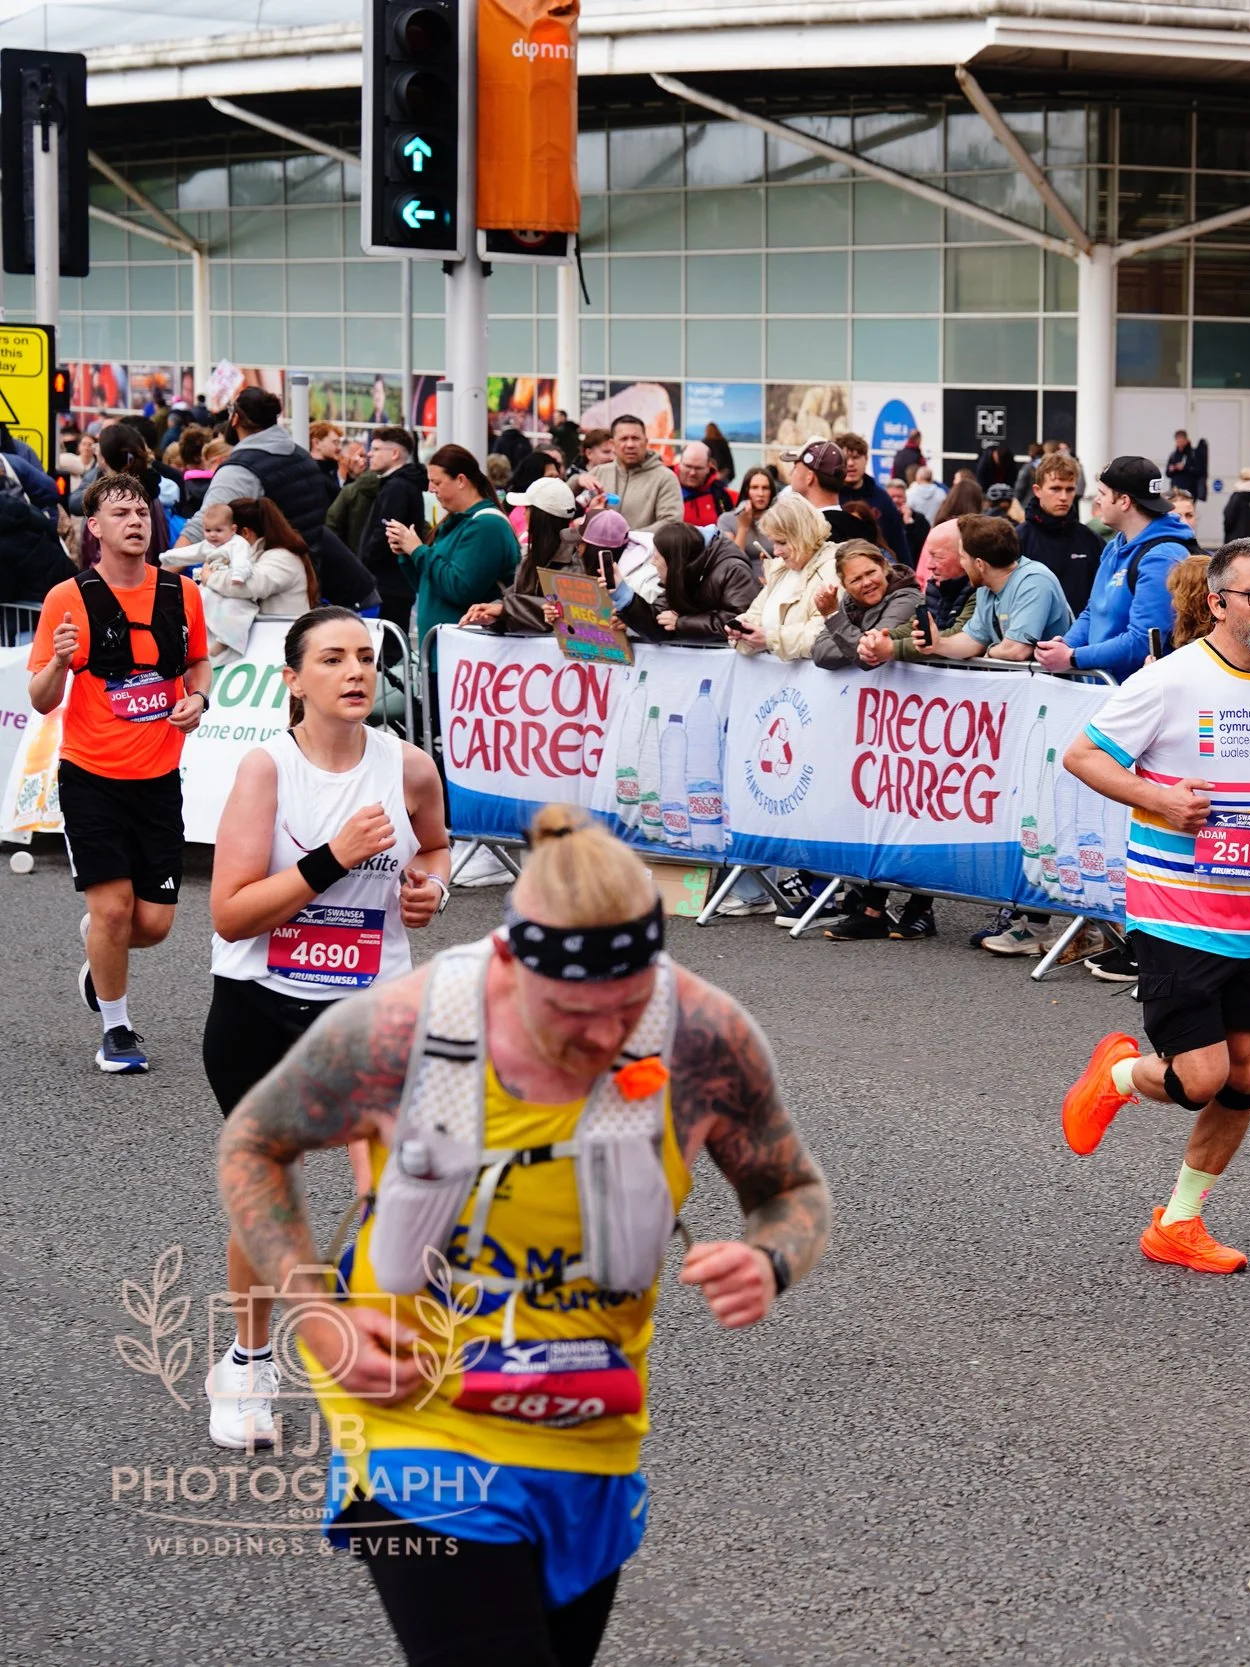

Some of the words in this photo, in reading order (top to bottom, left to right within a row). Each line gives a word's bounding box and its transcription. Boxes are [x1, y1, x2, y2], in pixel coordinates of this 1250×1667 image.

[14, 337, 29, 345] on
[1, 348, 23, 358] this
[111, 692, 132, 701] JOEL
[451, 659, 612, 721] BRECON
[127, 692, 168, 714] 4346
[0, 709, 28, 729] re
[856, 687, 1007, 761] BRECON
[197, 724, 231, 740] one
[233, 727, 256, 741] on
[450, 716, 605, 778] CARREG
[1220, 748, 1249, 758] wales
[763, 796, 778, 816] FOR
[779, 764, 814, 816] RECYCLING
[851, 751, 1002, 825] CARREG
[1197, 830, 1227, 840] ADAM
[327, 908, 365, 918] SWANSEA
[272, 927, 301, 939] AMY
[290, 941, 360, 969] 4690
[288, 972, 358, 985] #RUNSWANSEA
